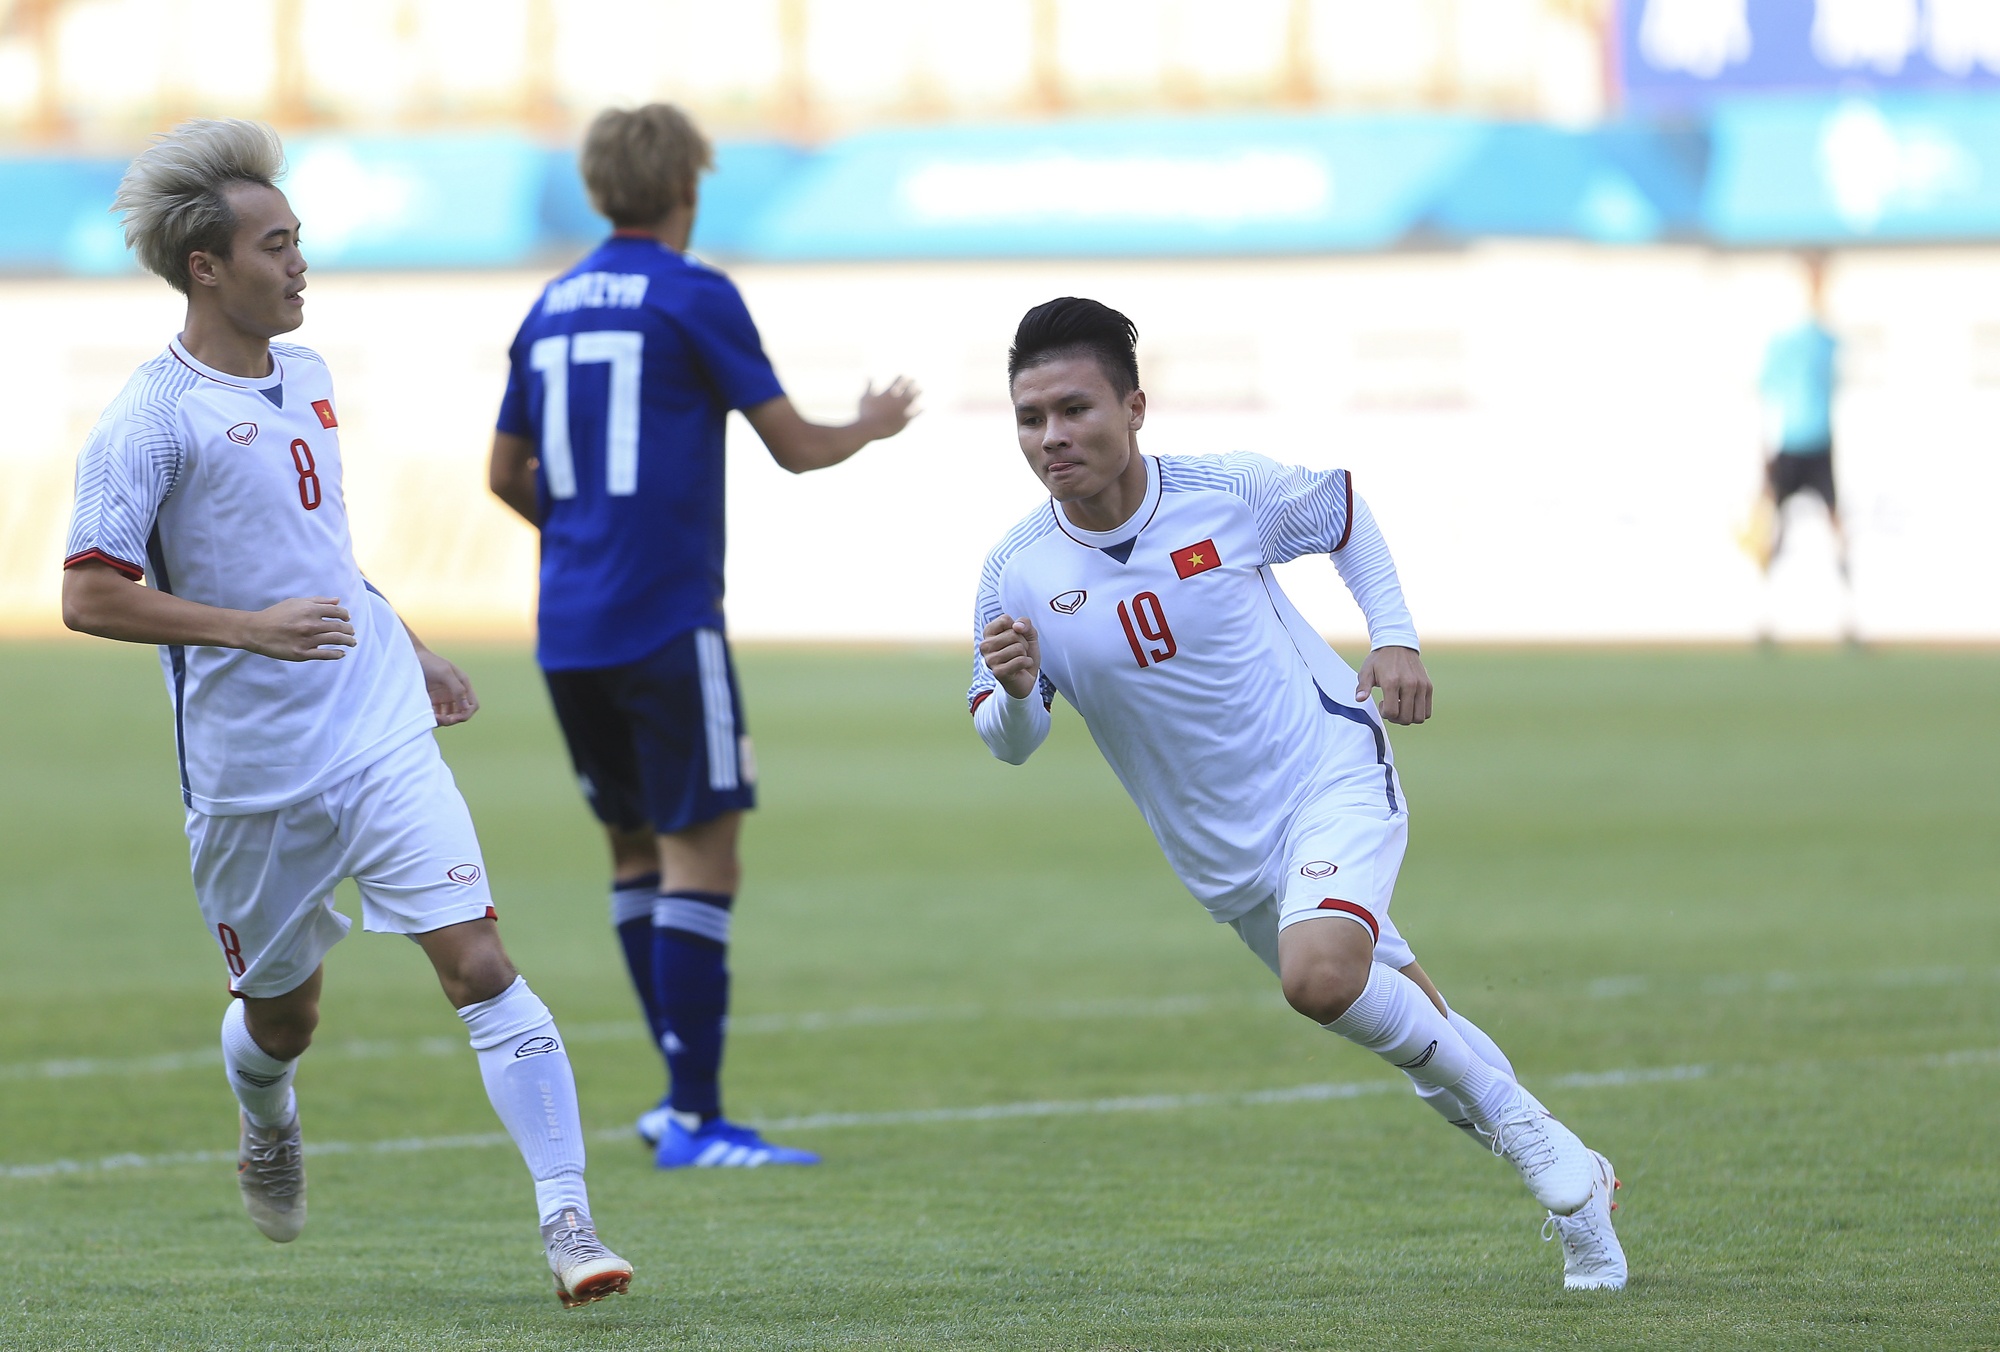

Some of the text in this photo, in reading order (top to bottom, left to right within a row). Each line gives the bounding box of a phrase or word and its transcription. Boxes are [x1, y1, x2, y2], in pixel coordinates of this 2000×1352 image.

[530, 330, 644, 499] 17
[290, 438, 321, 510] 8
[1117, 591, 1177, 668] 19
[217, 922, 246, 977] 8
